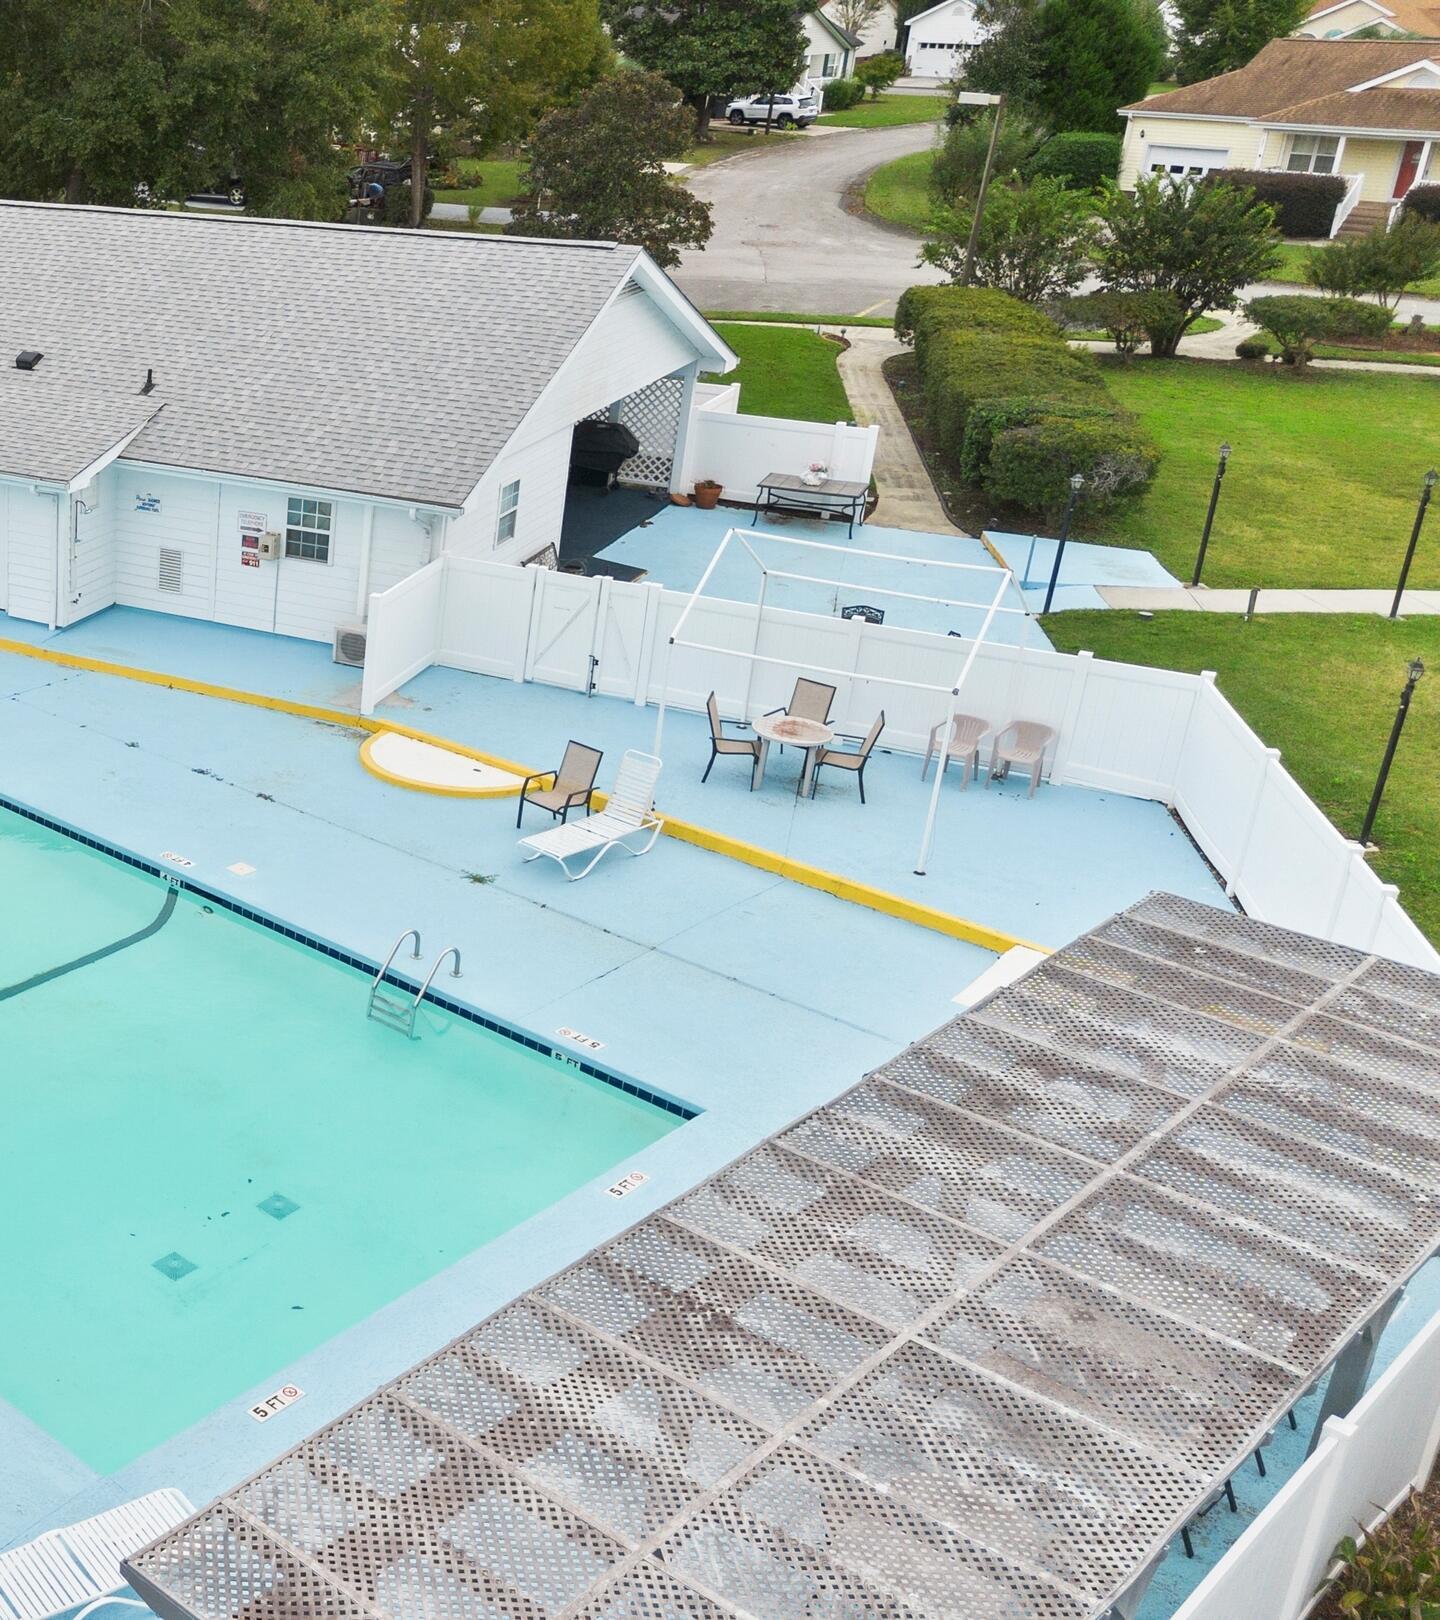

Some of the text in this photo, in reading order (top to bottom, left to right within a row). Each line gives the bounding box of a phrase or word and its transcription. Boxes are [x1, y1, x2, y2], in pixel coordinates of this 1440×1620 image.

[566, 1057, 579, 1068] FT
[609, 1179, 636, 1196] 5 FT
[252, 1395, 286, 1418] 5 FT
